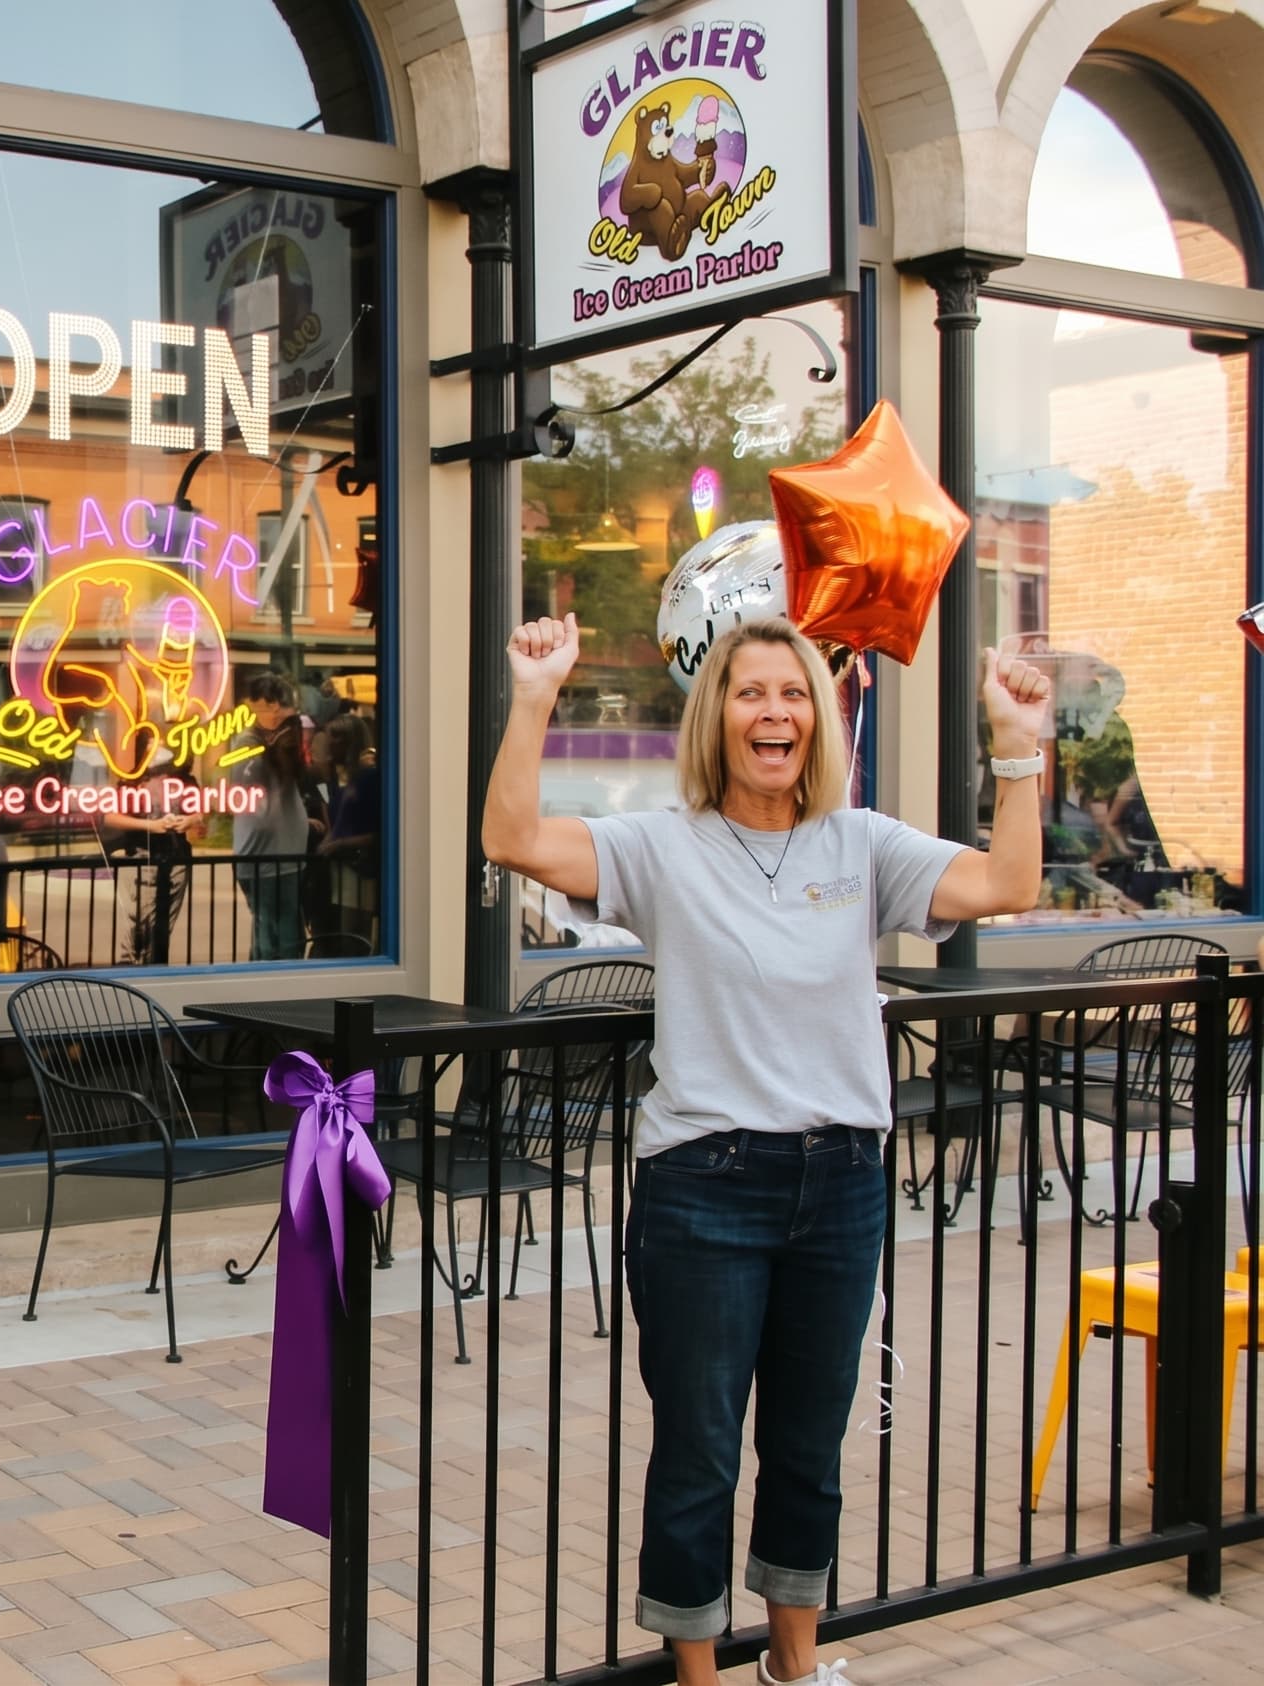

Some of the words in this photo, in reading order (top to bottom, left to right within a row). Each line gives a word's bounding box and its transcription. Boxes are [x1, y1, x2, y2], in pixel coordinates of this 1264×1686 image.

[579, 20, 767, 137] GLACIER
[588, 217, 643, 266] Old
[700, 165, 776, 244] Town
[573, 288, 609, 322] Ice
[612, 265, 691, 308] Cream
[696, 240, 783, 288] Parlor
[167, 704, 256, 767] Town
[36, 776, 151, 815] Cream
[162, 777, 264, 815] Parlor
